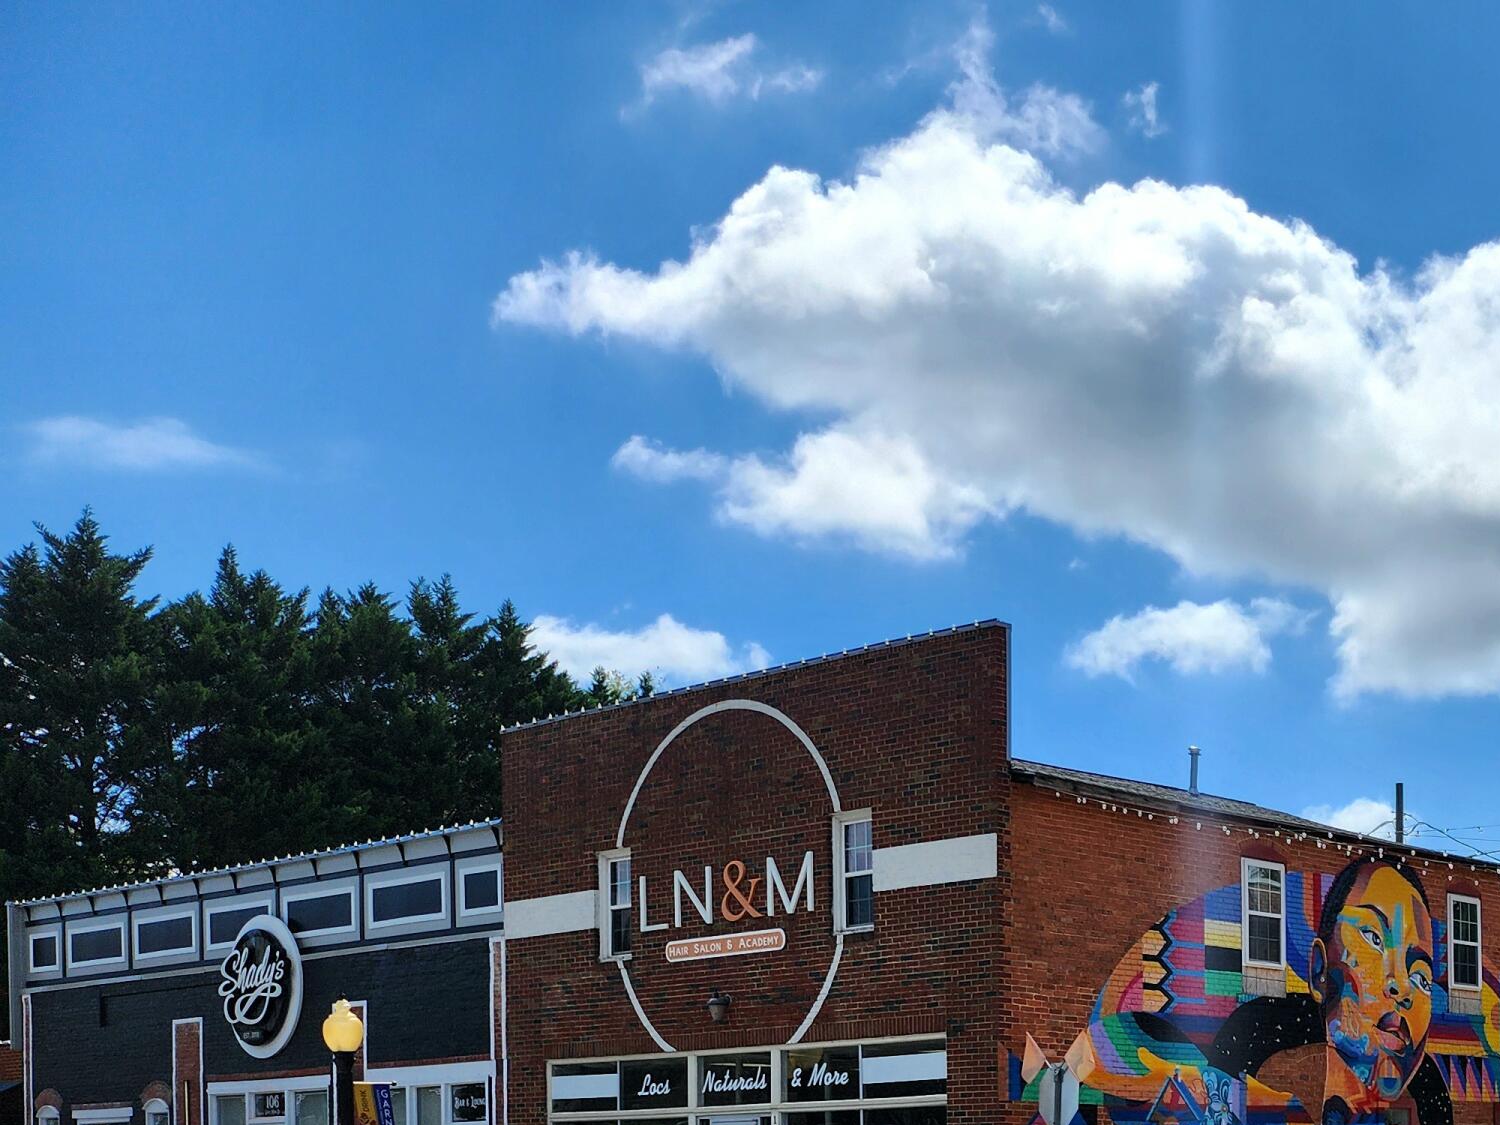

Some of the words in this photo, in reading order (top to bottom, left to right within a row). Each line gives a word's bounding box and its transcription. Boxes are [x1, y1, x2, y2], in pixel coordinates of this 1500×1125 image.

[639, 850, 815, 932] LN&M
[668, 946, 689, 957] HAIR
[694, 942, 721, 954] SALON
[727, 940, 733, 950] &
[739, 935, 779, 949] ACADEMY
[218, 945, 285, 1025] Shady's
[637, 1073, 671, 1096] Locs
[702, 1066, 767, 1093] Naturals
[791, 1068, 802, 1087] &
[807, 1062, 849, 1087] More
[266, 1094, 280, 1109] 106
